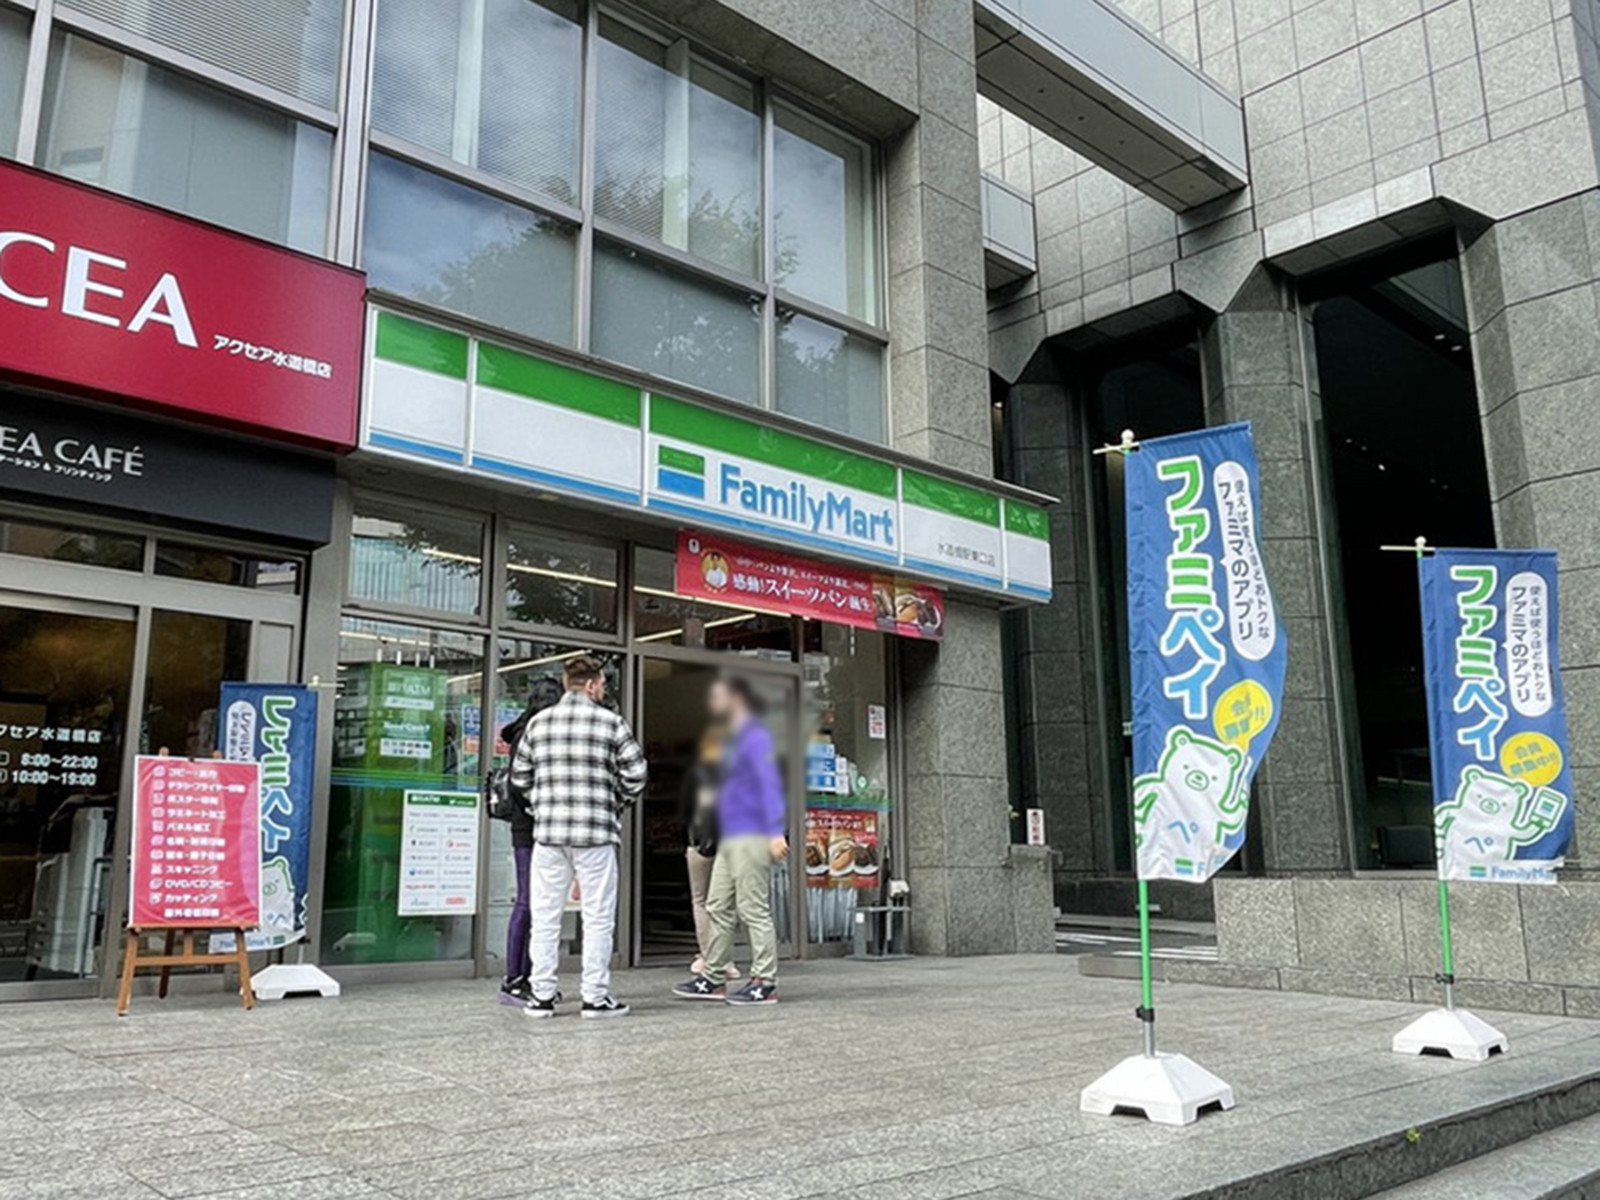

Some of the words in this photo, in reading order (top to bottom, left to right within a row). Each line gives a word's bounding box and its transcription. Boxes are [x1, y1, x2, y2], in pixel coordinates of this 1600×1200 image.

[213, 334, 332, 379] アクセア水道橋店
[54, 439, 144, 476] CAFÉ
[720, 462, 894, 546] FamilyMart
[1157, 456, 1227, 719] ファミペイ
[1218, 482, 1253, 640] ファミマのアプリ
[1451, 565, 1508, 761] ファミペイ
[1512, 586, 1531, 702] ファミマのアプリ
